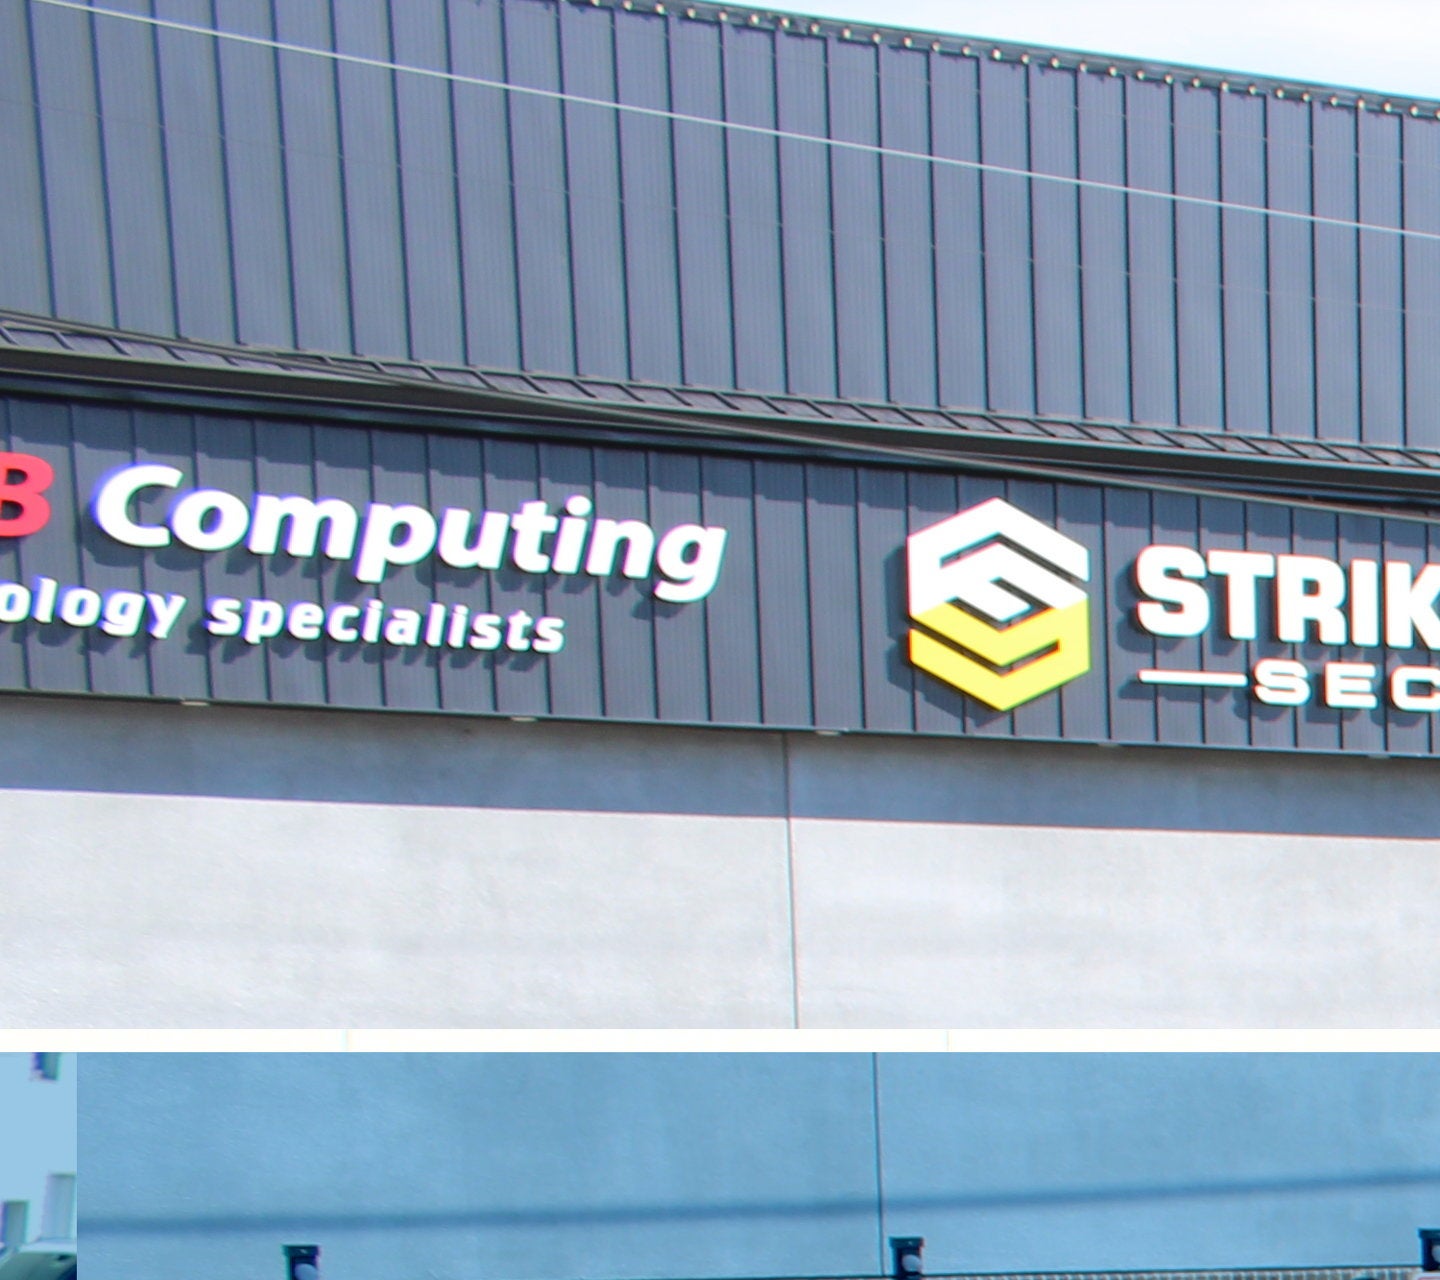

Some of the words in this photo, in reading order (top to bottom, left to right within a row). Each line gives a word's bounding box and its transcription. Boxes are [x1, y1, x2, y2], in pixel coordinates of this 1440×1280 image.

[91, 463, 727, 604] Computing
[0, 575, 187, 639] ology
[205, 596, 566, 654] specialists
